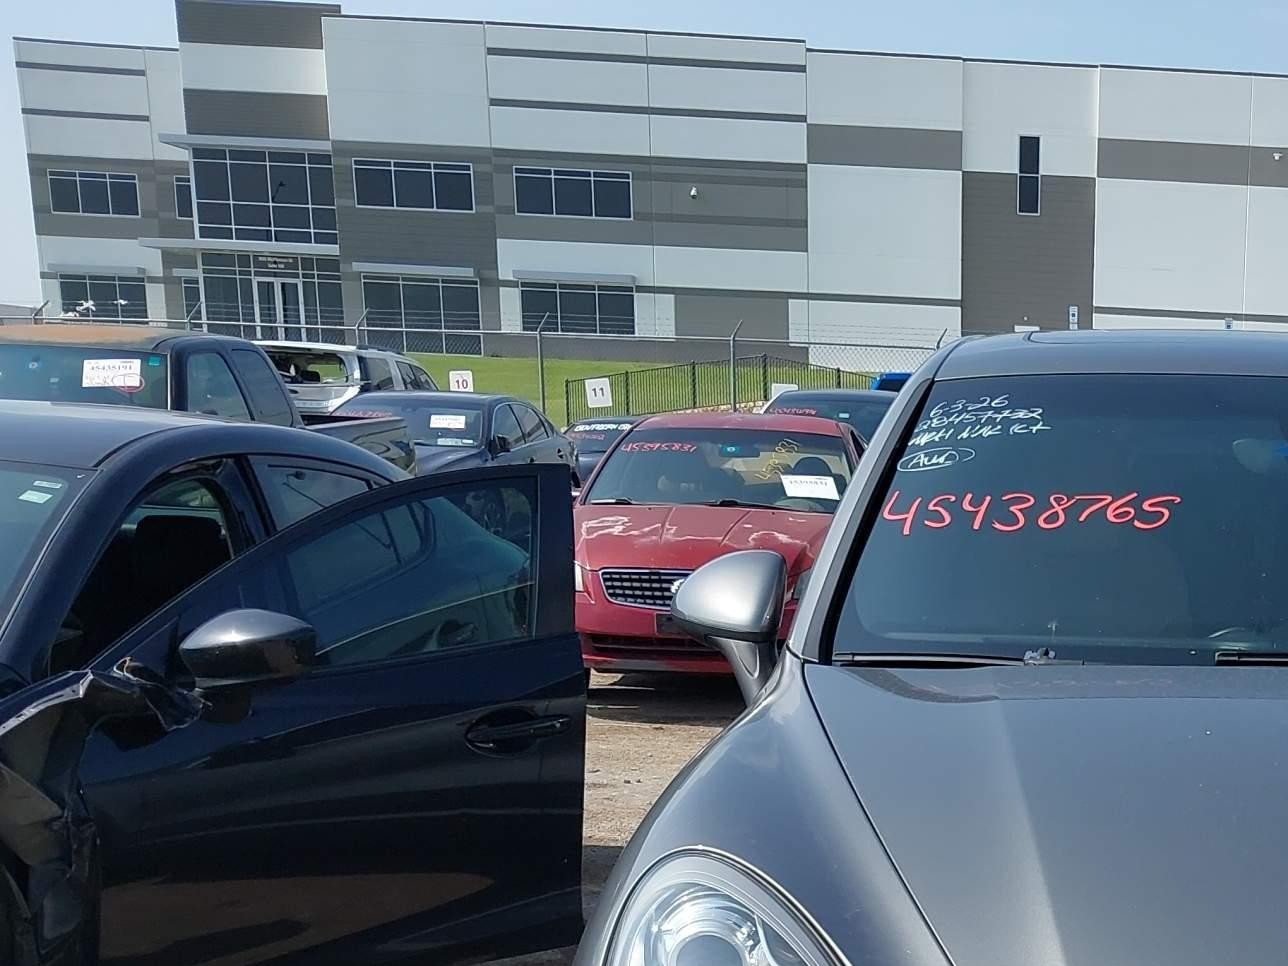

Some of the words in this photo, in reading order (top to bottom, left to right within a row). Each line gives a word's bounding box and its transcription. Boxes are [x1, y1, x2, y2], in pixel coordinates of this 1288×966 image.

[455, 379, 469, 390] 10
[591, 387, 606, 398] 11
[882, 490, 1182, 536] 45438765
